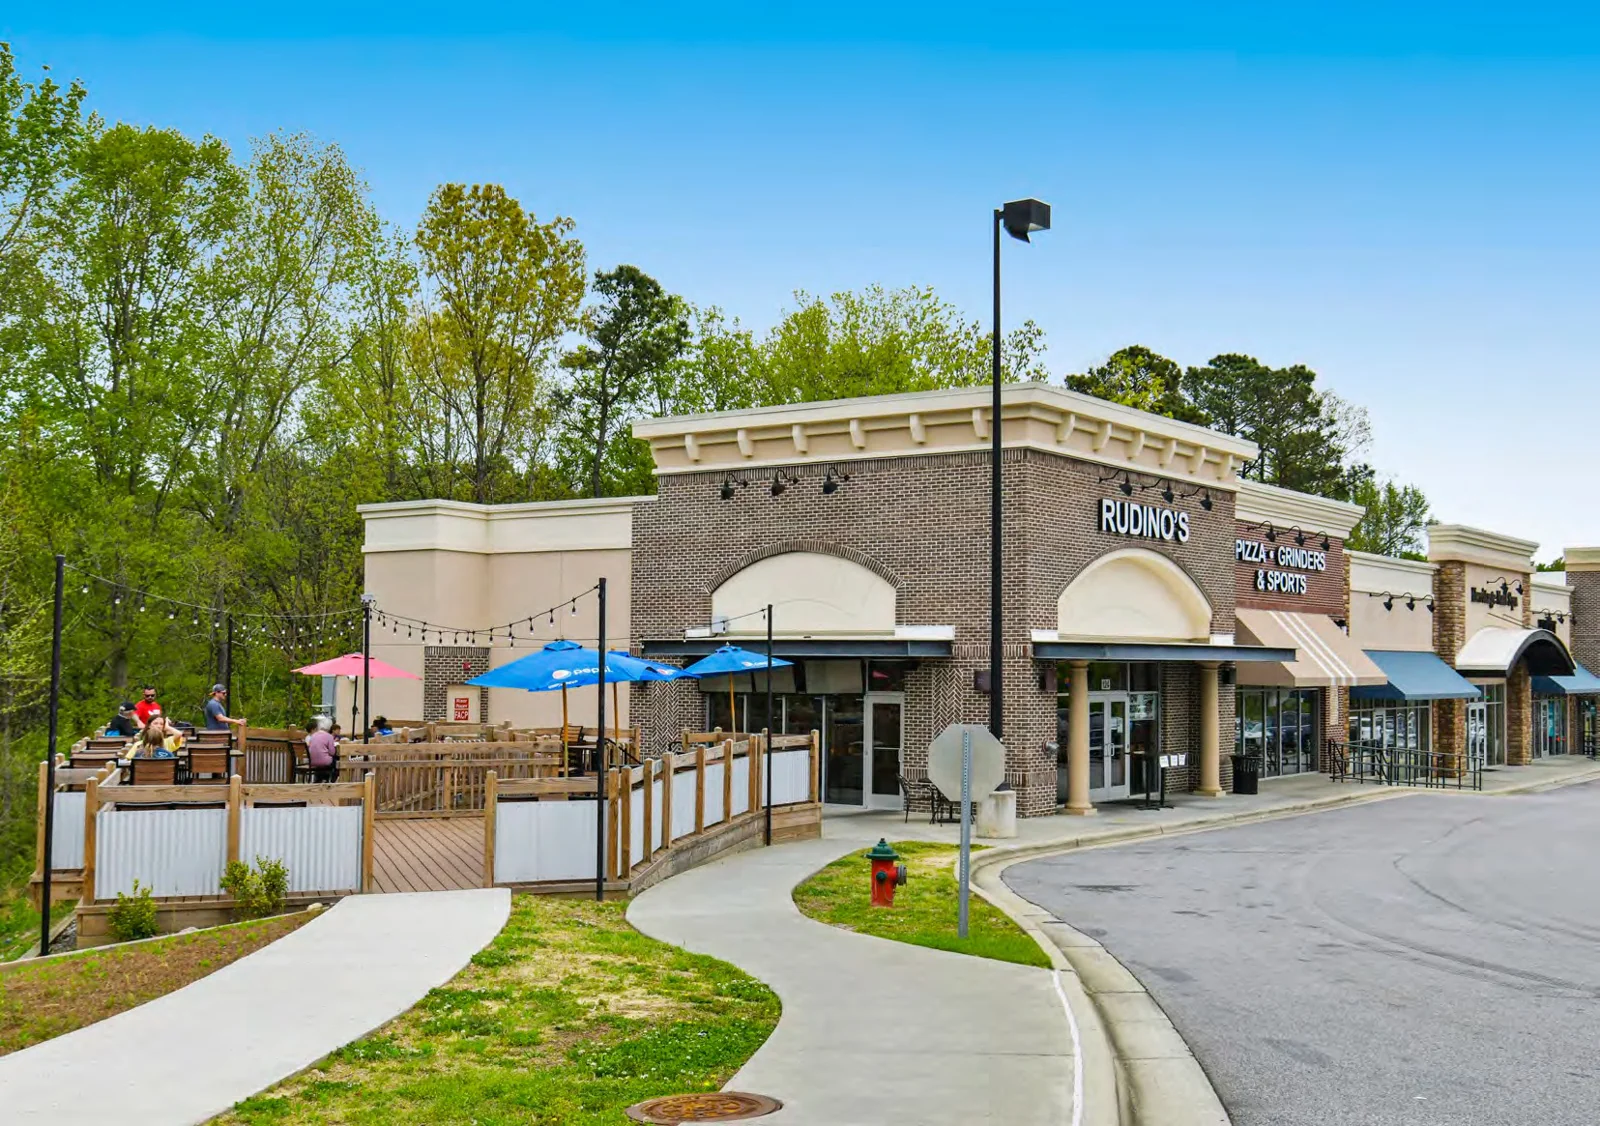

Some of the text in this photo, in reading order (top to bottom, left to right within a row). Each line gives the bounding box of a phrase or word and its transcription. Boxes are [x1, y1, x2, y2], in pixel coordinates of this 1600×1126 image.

[1101, 498, 1190, 543] RUDINO'S
[1235, 539, 1326, 571] PIZZA GRINDERS
[1257, 569, 1307, 595] & SPORTS
[573, 665, 612, 675] pepi
[455, 710, 468, 719] FACP
